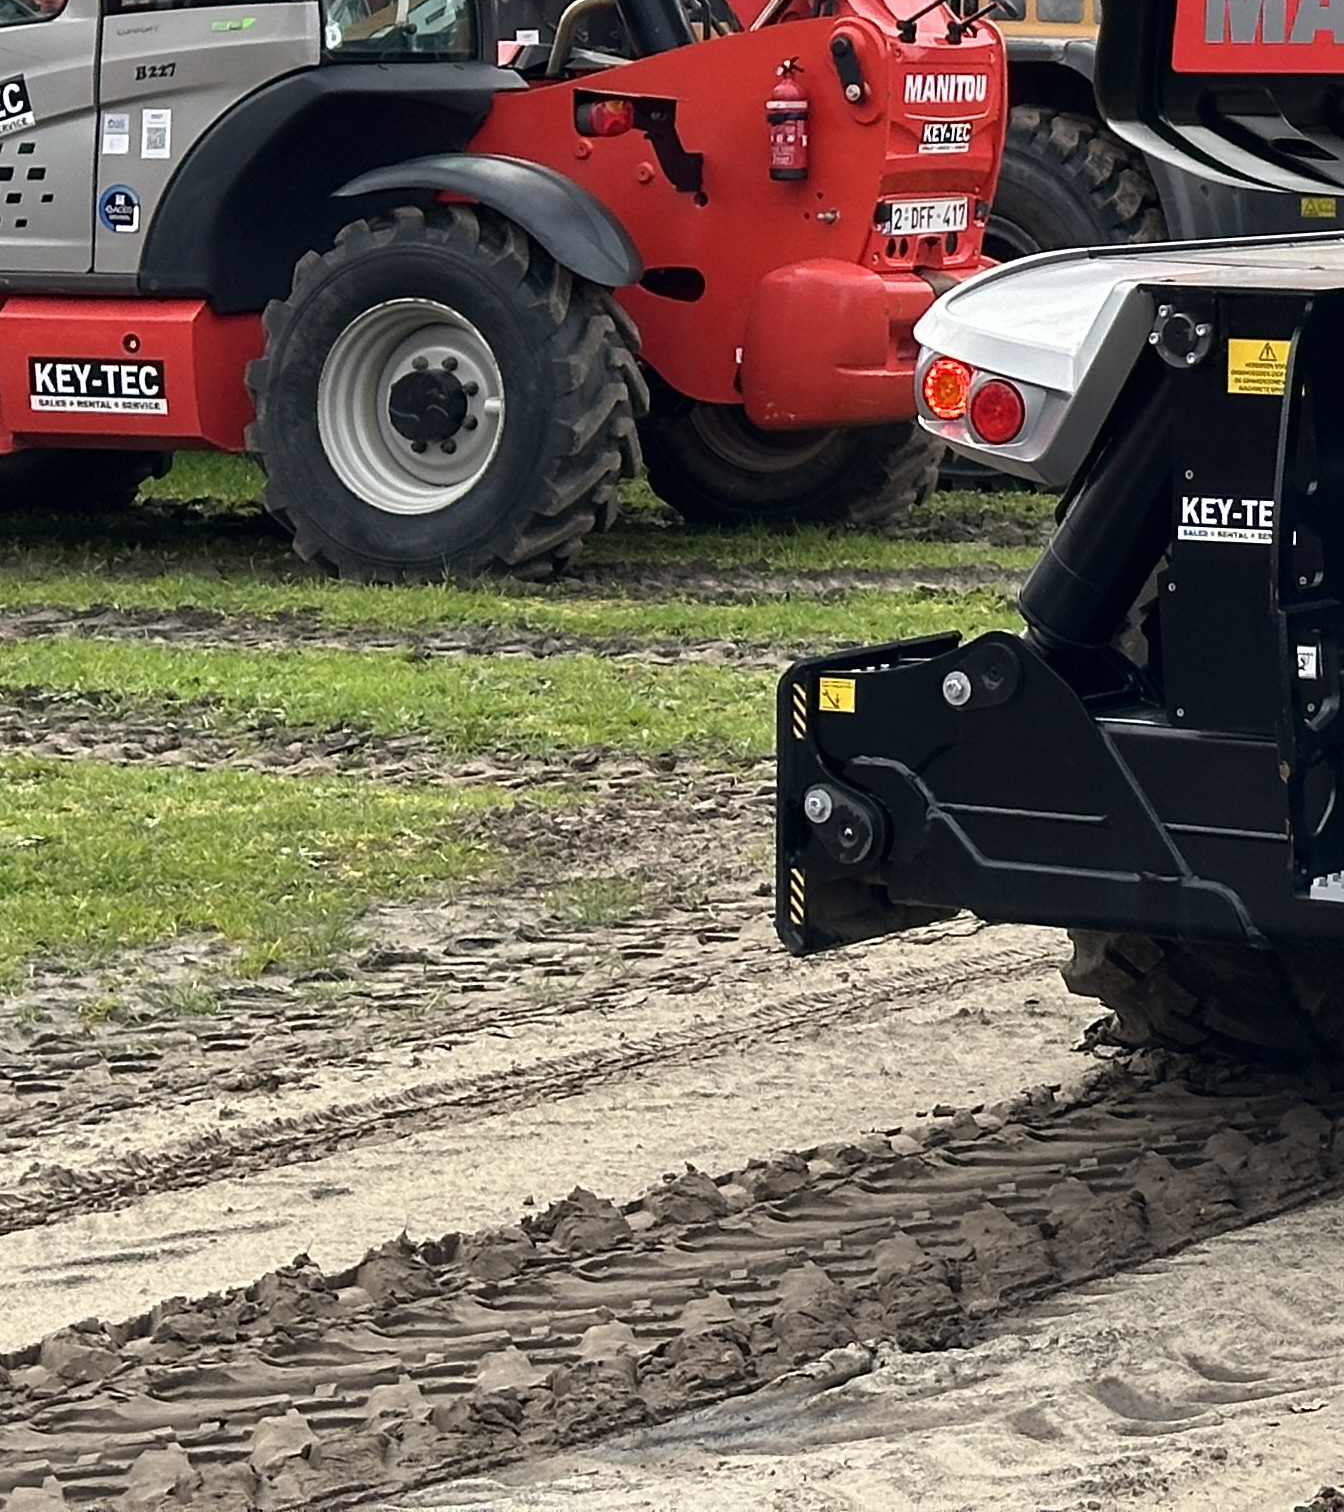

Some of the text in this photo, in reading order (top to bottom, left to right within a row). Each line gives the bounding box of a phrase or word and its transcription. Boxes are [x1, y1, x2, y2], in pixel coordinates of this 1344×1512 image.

[135, 62, 177, 81] B227
[904, 74, 987, 104] MANITOU
[922, 123, 973, 143] KEY-TEC
[34, 362, 159, 396] KEY-TEC
